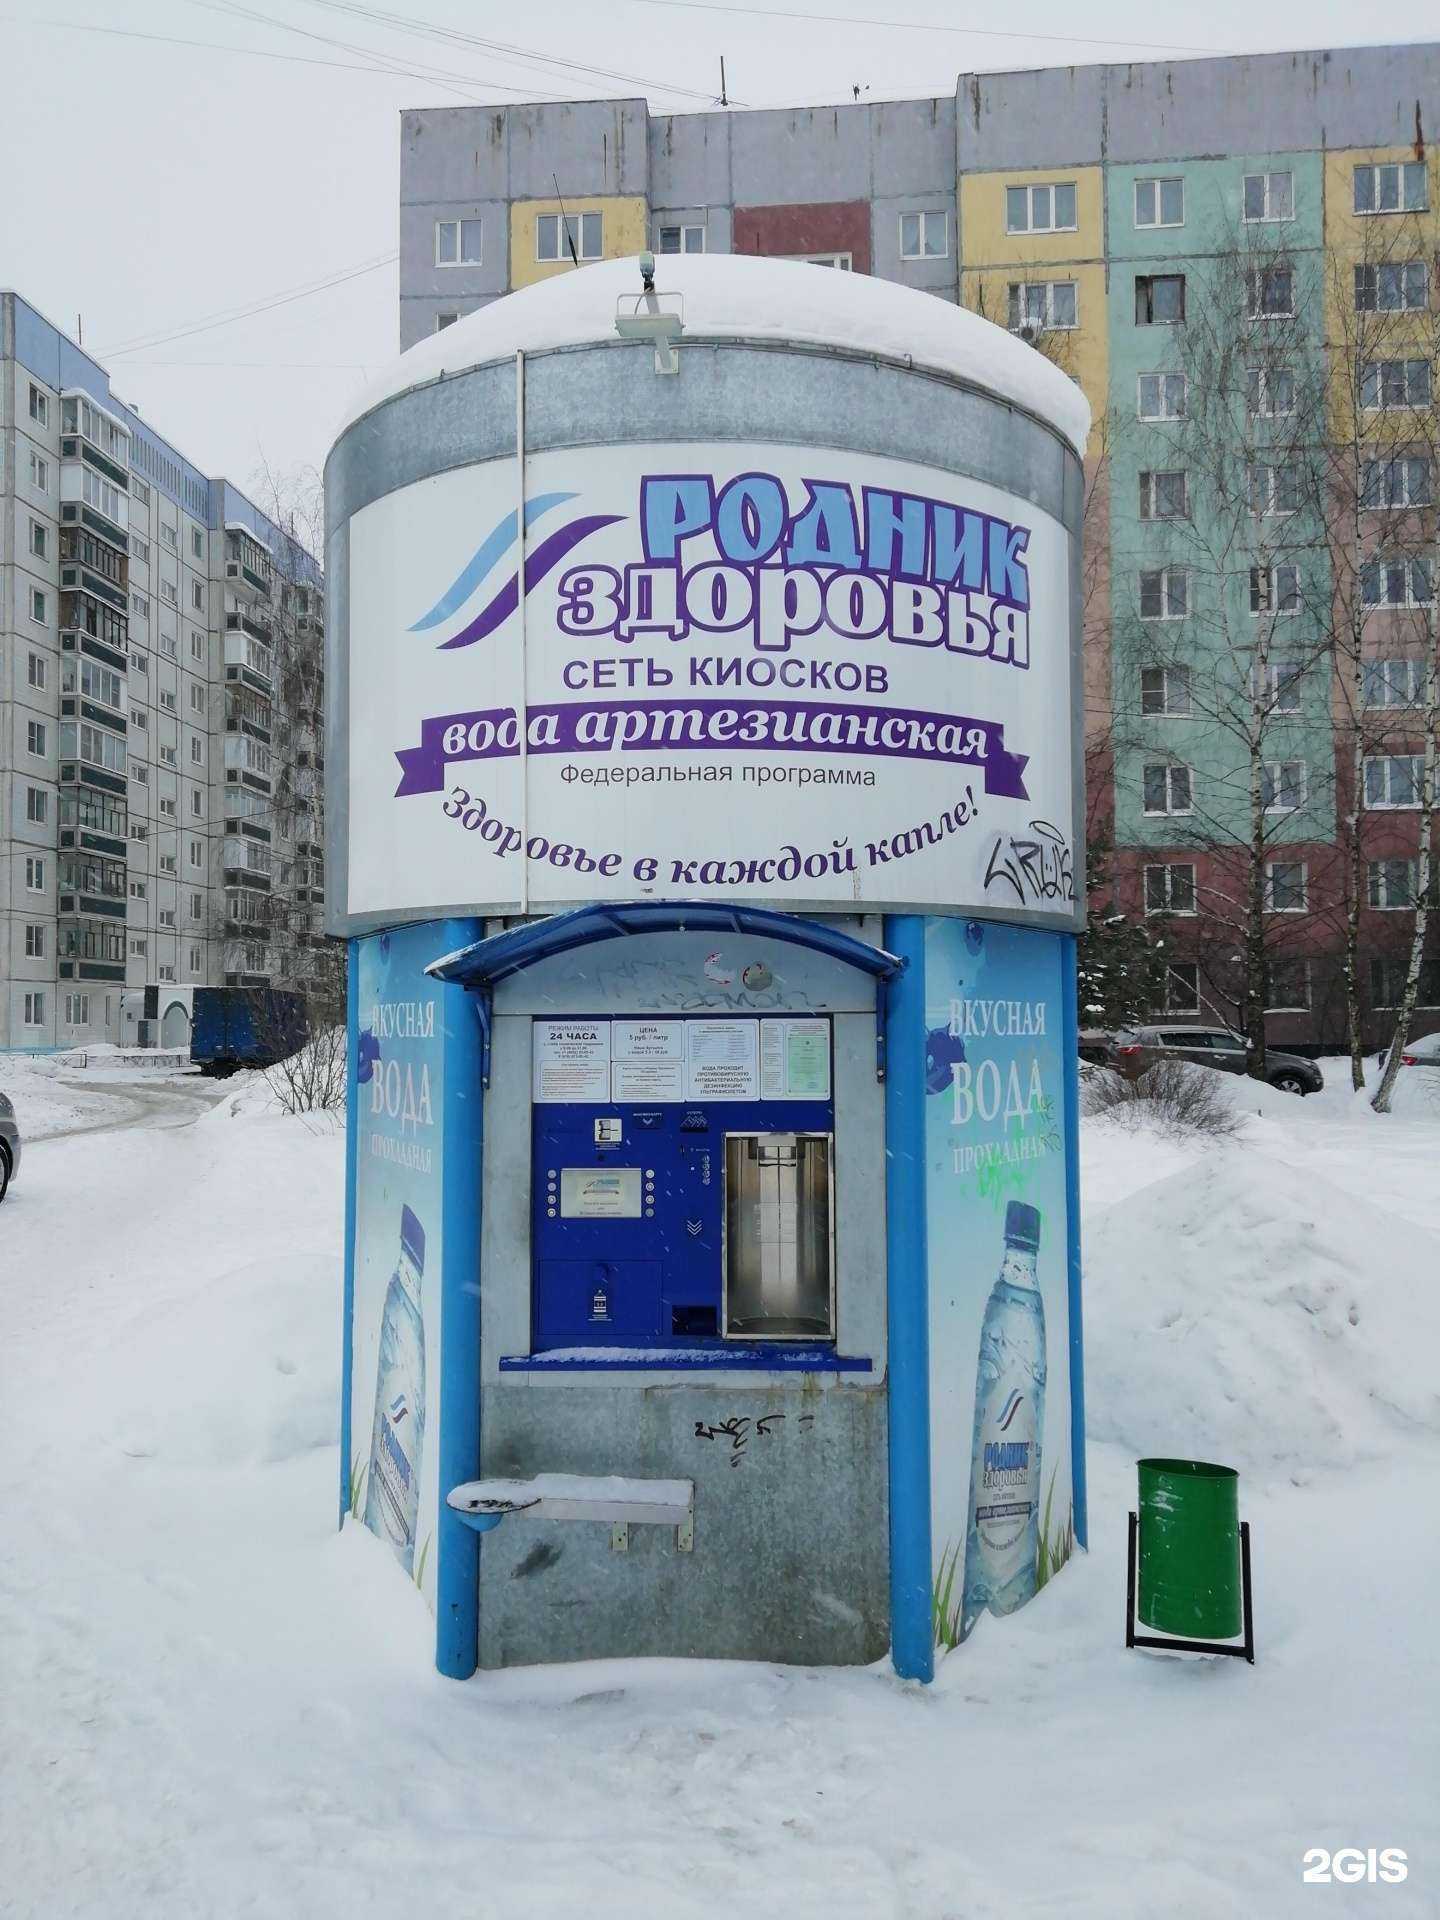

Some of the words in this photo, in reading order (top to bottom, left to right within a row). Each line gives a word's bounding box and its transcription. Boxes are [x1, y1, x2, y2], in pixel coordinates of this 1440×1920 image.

[640, 471, 1032, 611] РОДНИК
[562, 657, 674, 690] СЕТЬ
[689, 656, 890, 694] КИОСКОВ
[442, 707, 562, 755] вода
[575, 708, 989, 759] артезианская
[560, 764, 733, 788] Федеральная
[742, 765, 877, 788] программа
[442, 785, 623, 878] Здоровье
[632, 857, 659, 882] в
[670, 836, 858, 885] каждой
[864, 784, 979, 866] капле!
[371, 1000, 435, 1039] ВКУСНАЯ
[550, 1032, 563, 1040] 24
[566, 1032, 598, 1040] ЧАСА
[949, 999, 1047, 1038] ВКУСНАЯ
[370, 1058, 434, 1137] ВОДА
[950, 1058, 1048, 1132] ВОДА
